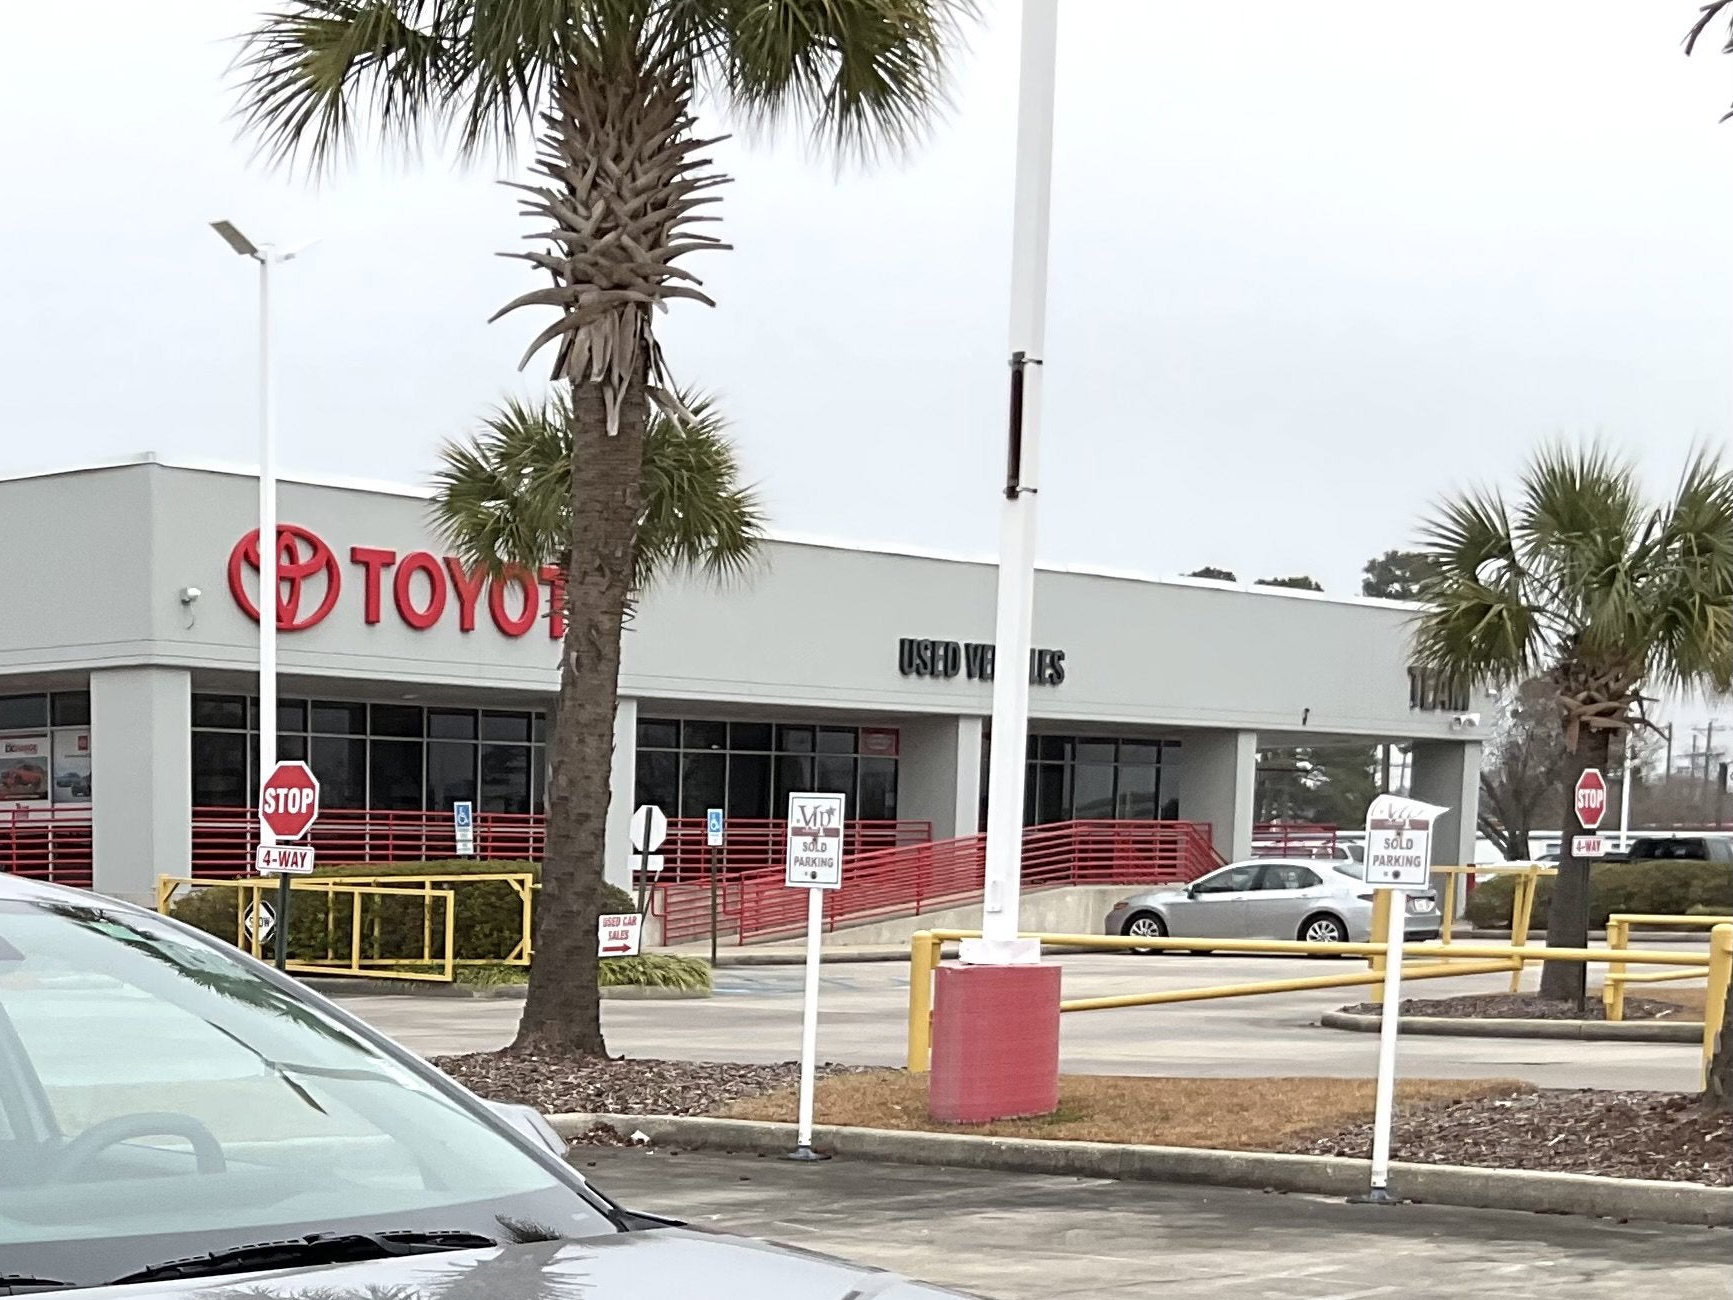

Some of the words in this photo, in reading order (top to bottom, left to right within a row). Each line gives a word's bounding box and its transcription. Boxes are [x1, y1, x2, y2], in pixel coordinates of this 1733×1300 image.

[350, 546, 565, 639] TOYOT
[899, 638, 961, 677] USED
[964, 643, 1065, 685] VELES
[264, 787, 314, 814] STOP
[1578, 789, 1603, 809] STOP
[802, 841, 827, 853] SOLD
[1383, 838, 1413, 850] SOLD
[1576, 839, 1601, 852] 4-WAY
[263, 850, 307, 869] 4-WAY
[793, 855, 834, 868] PARKING
[1372, 854, 1422, 868] PARKING
[622, 915, 638, 926] CAR
